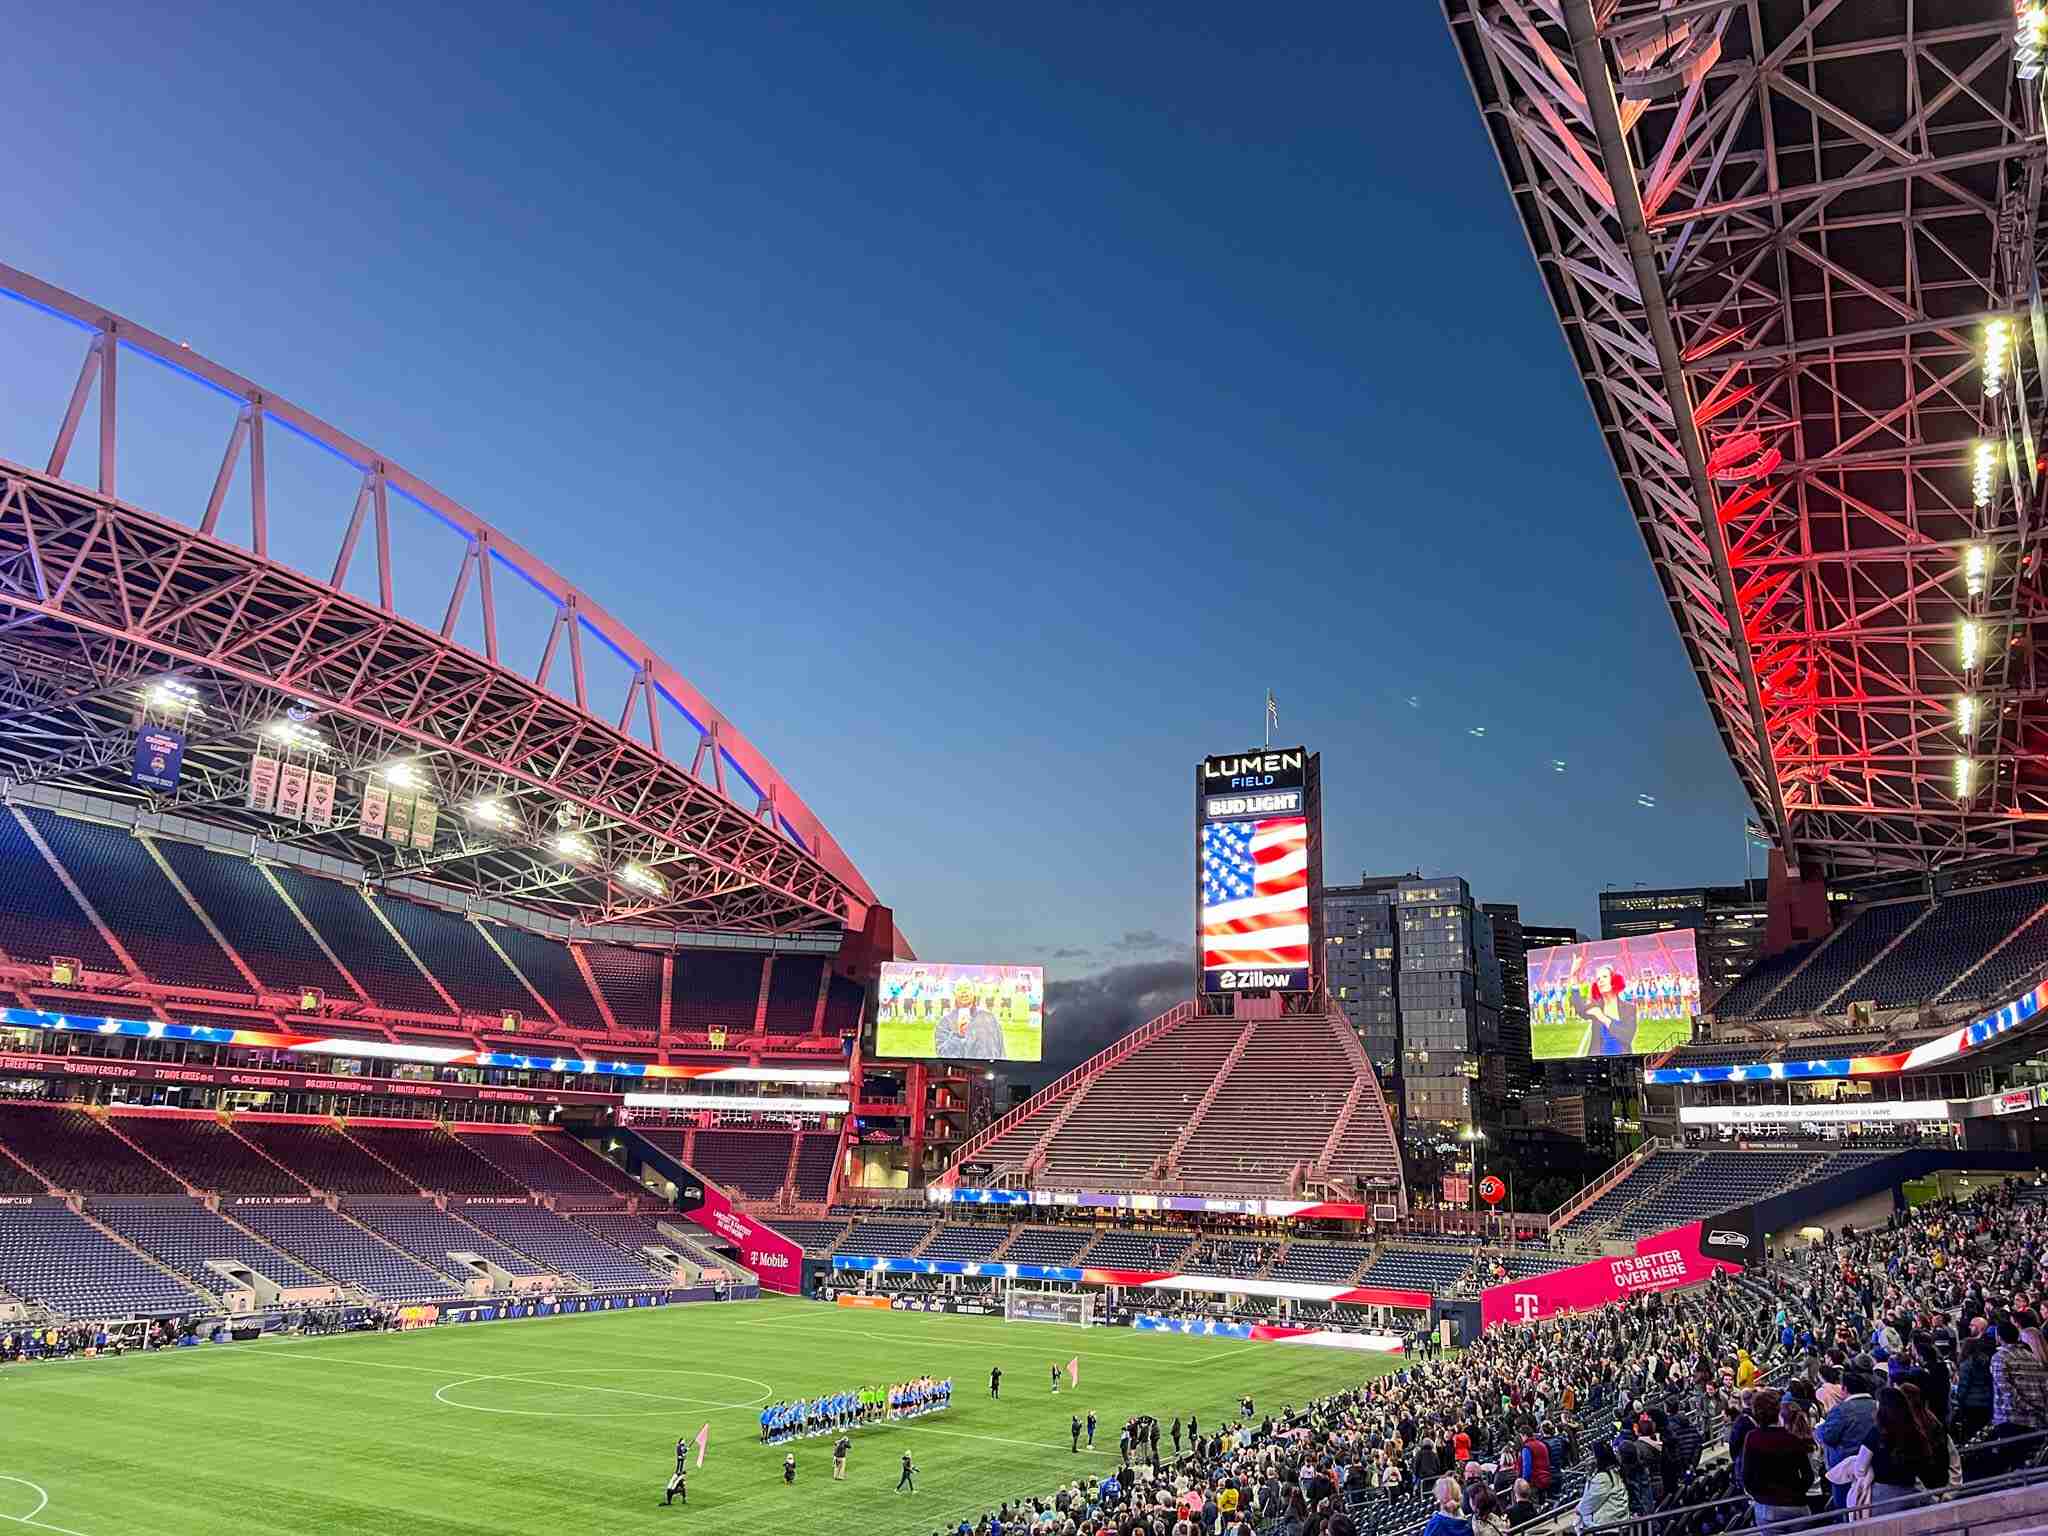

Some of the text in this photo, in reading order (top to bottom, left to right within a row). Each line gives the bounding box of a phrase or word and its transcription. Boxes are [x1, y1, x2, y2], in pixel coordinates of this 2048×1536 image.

[1205, 752, 1302, 778] LUMEN
[1231, 775, 1275, 788] FIELD
[1209, 795, 1298, 816] BUD LIGHT
[1237, 971, 1290, 988] Zillow
[64, 1062, 76, 1073] 45
[1480, 1182, 1495, 1196] 76
[760, 1252, 789, 1268] Mobile
[1611, 1249, 1681, 1274] IT'S BETTER
[1614, 1269, 1650, 1287] OVER
[1651, 1261, 1687, 1280] HERE
[892, 1301, 907, 1311] ally
[911, 1301, 926, 1312] ally
[929, 1302, 944, 1312] ally
[1514, 1293, 1540, 1321] T
